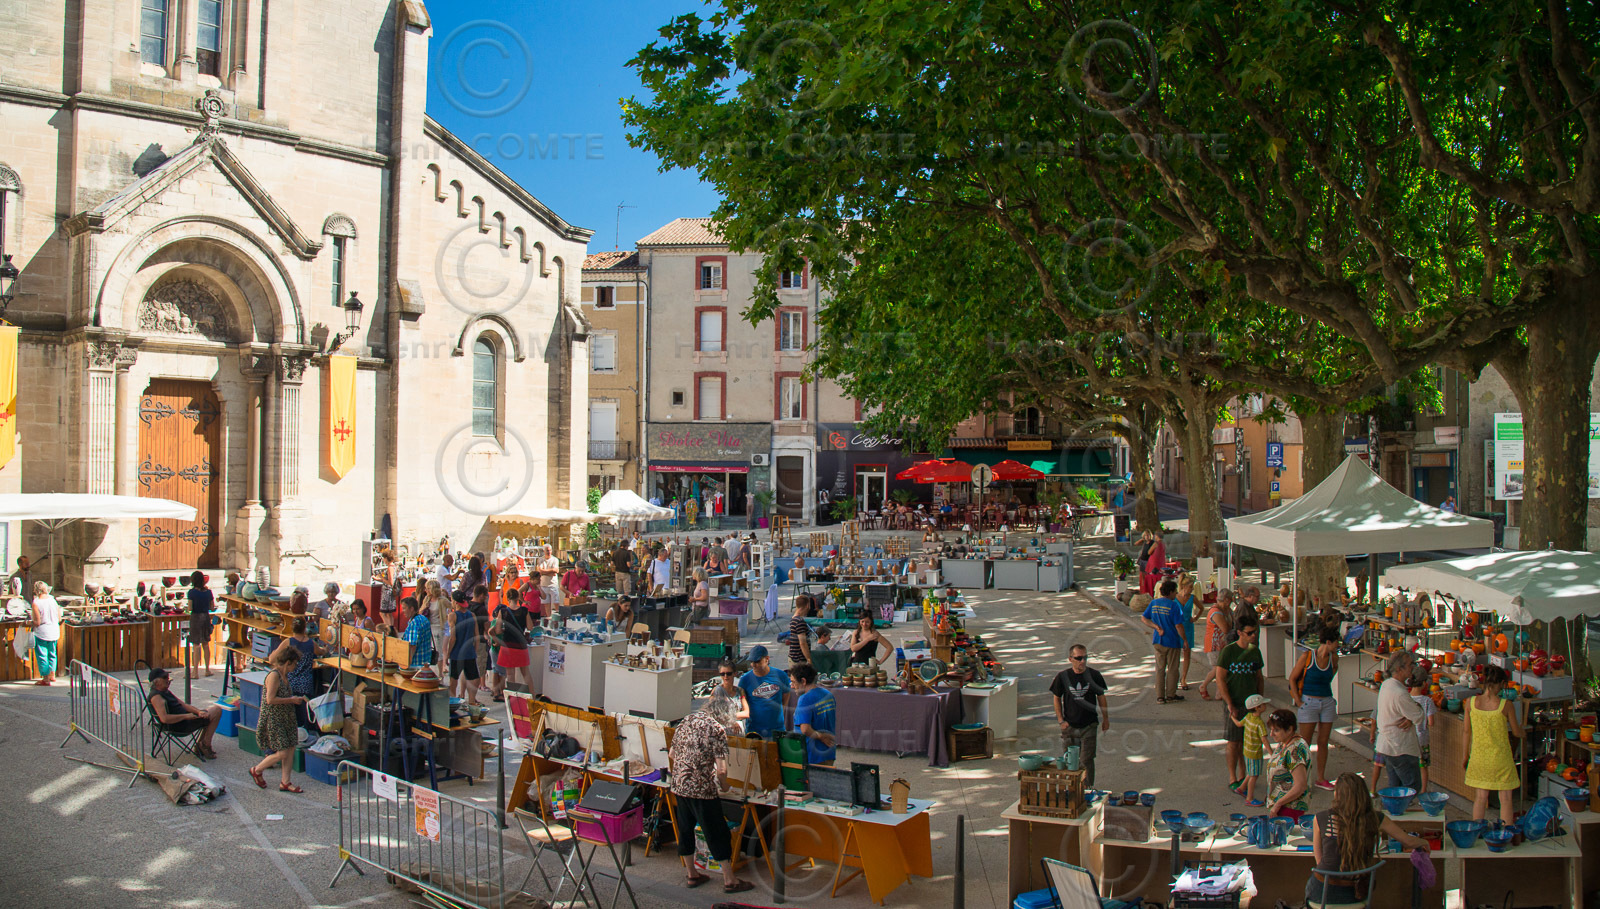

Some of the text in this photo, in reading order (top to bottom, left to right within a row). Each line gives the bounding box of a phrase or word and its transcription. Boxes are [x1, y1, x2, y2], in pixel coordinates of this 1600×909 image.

[659, 430, 743, 447] Dolce Vita
[1272, 446, 1279, 455] P
